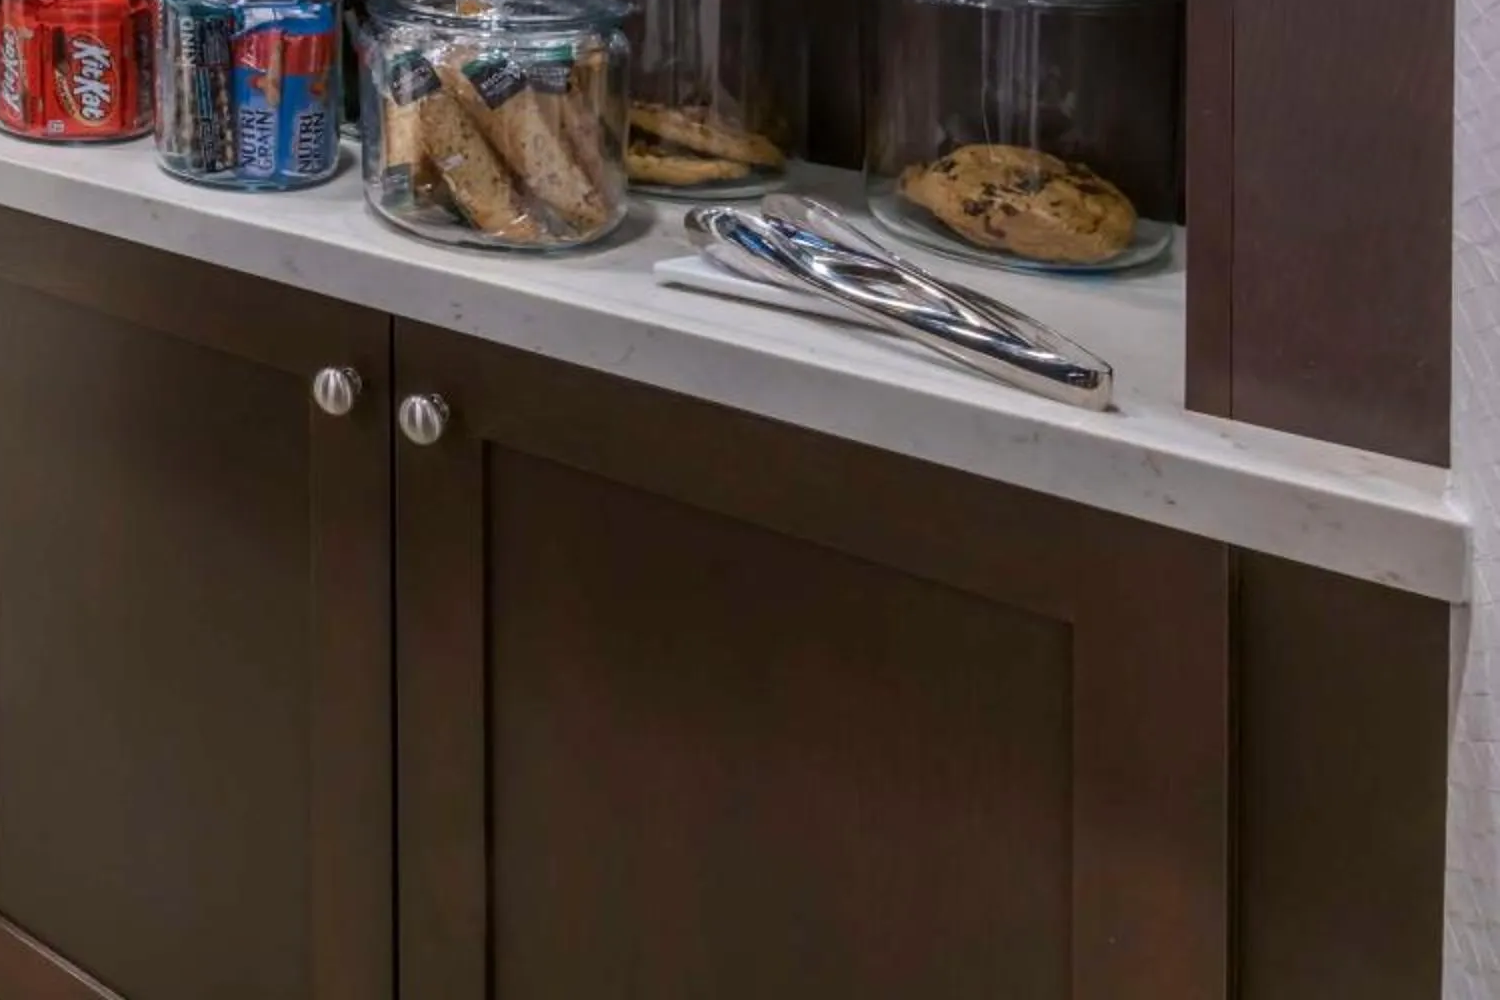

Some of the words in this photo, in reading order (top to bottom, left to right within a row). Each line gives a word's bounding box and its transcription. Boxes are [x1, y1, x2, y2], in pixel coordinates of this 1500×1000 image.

[180, 16, 197, 70] KIND
[241, 107, 257, 169] NUTRI
[256, 108, 274, 171] GRAIN
[297, 112, 313, 174] NUTRI
